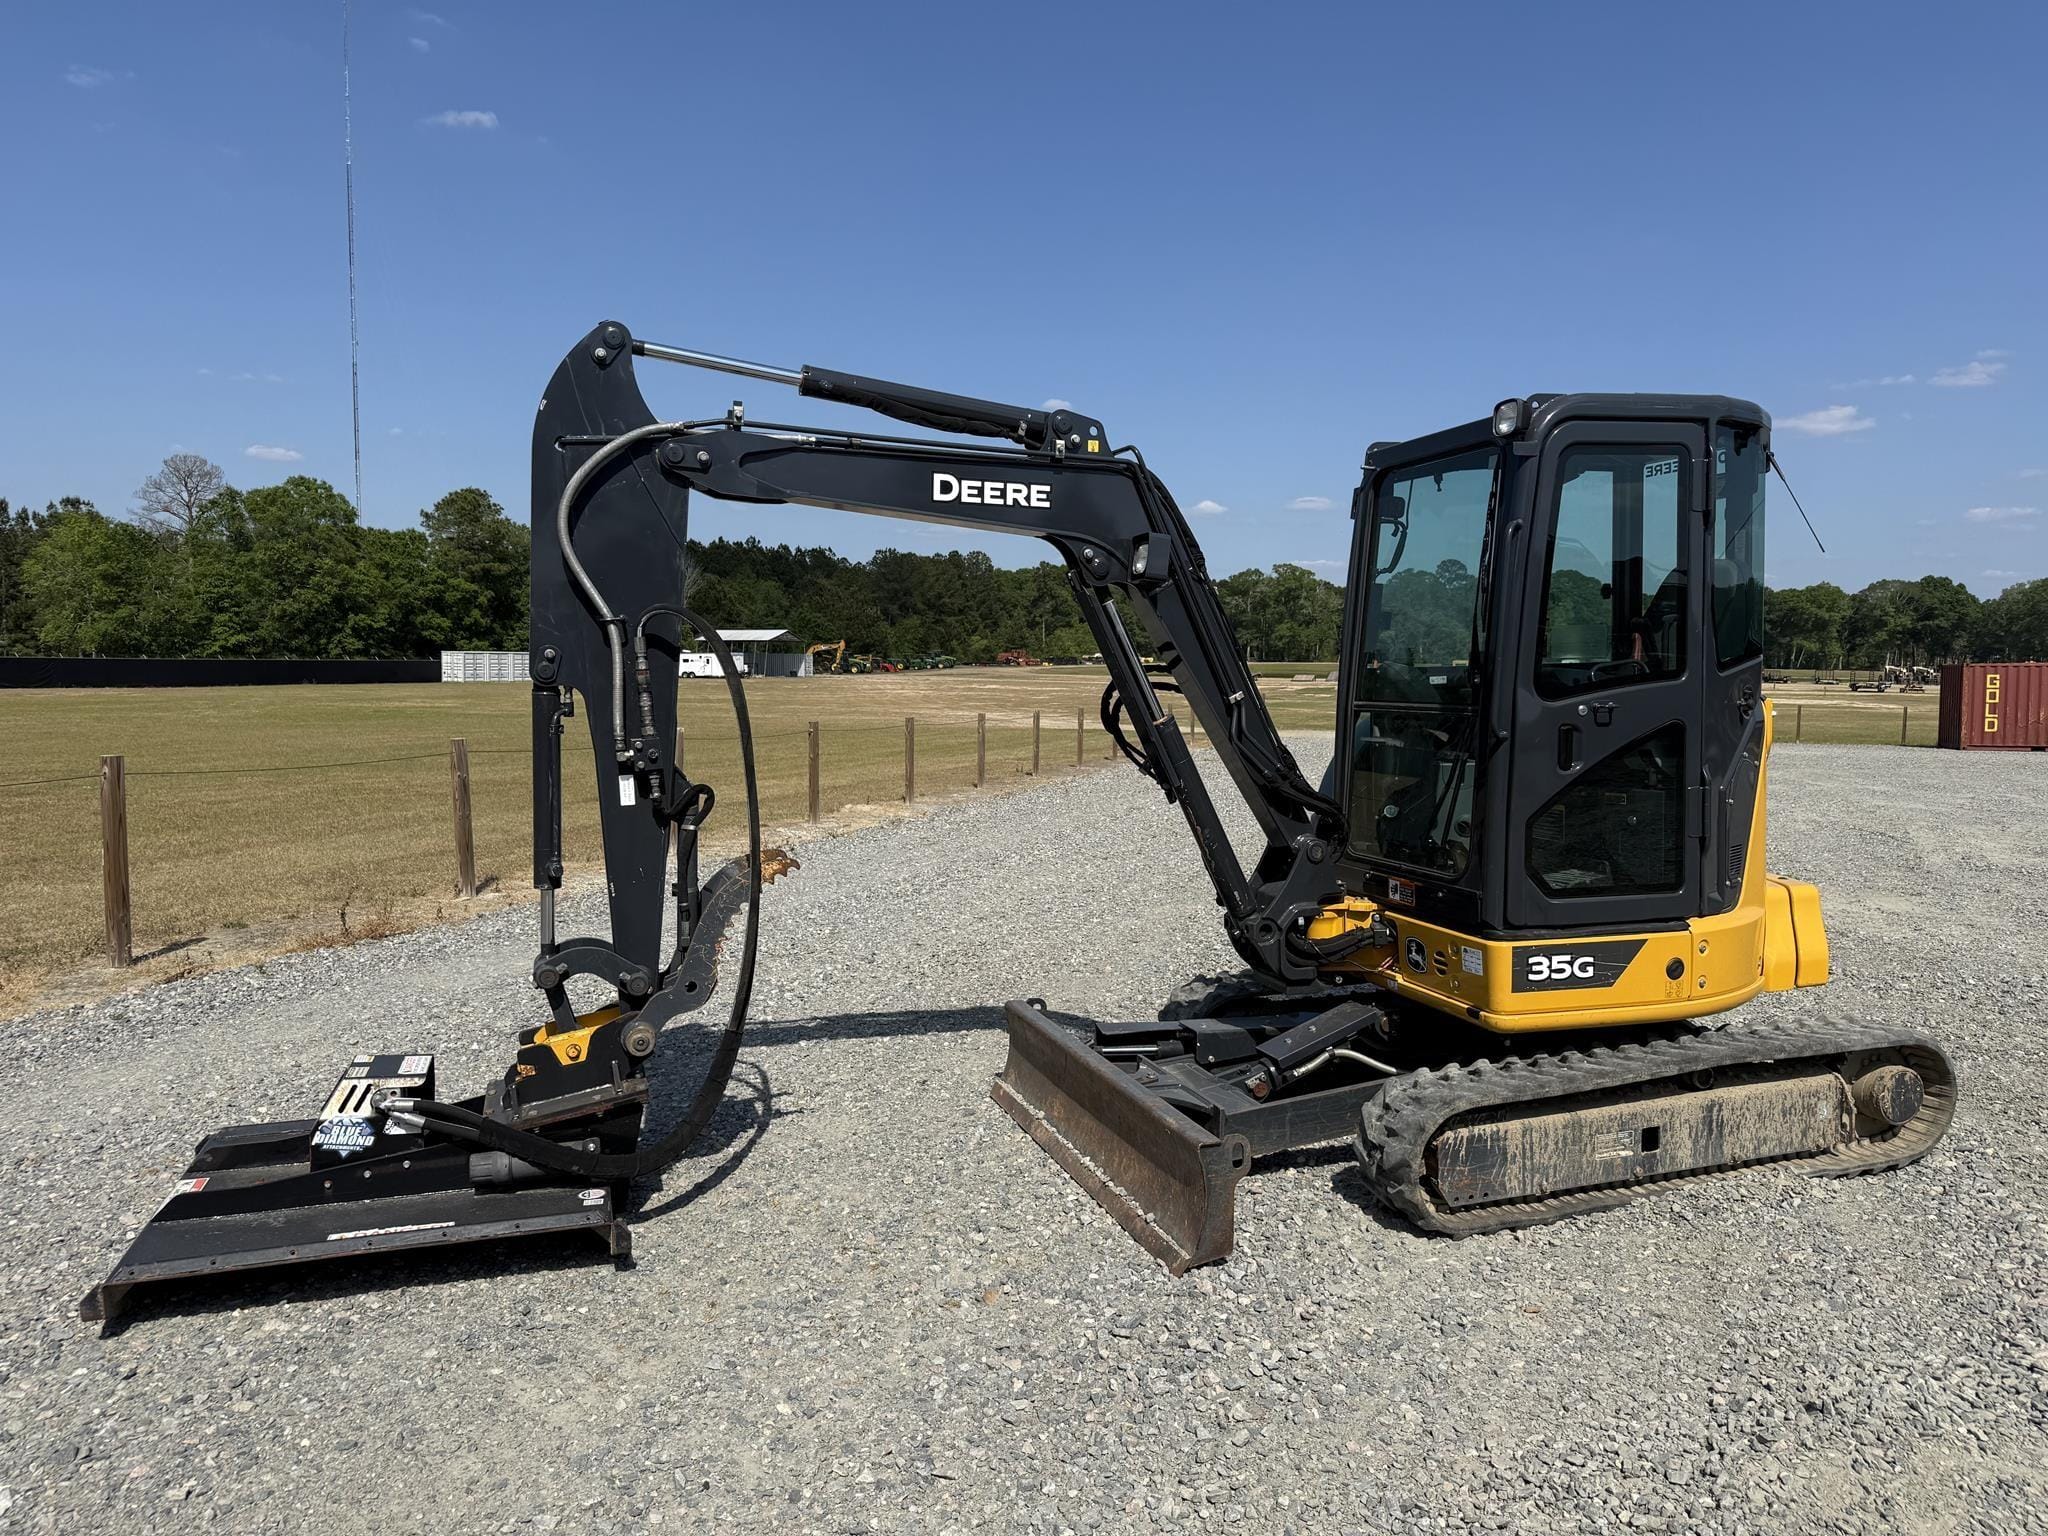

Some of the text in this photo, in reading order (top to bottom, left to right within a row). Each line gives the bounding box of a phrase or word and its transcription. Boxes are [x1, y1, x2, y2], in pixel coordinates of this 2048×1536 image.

[932, 472, 1051, 509] DEERE
[1984, 674, 2000, 732] GOLD
[1527, 954, 1594, 981] 35G
[314, 1133, 375, 1146] DIAMOND
[331, 1125, 363, 1137] BLUE
